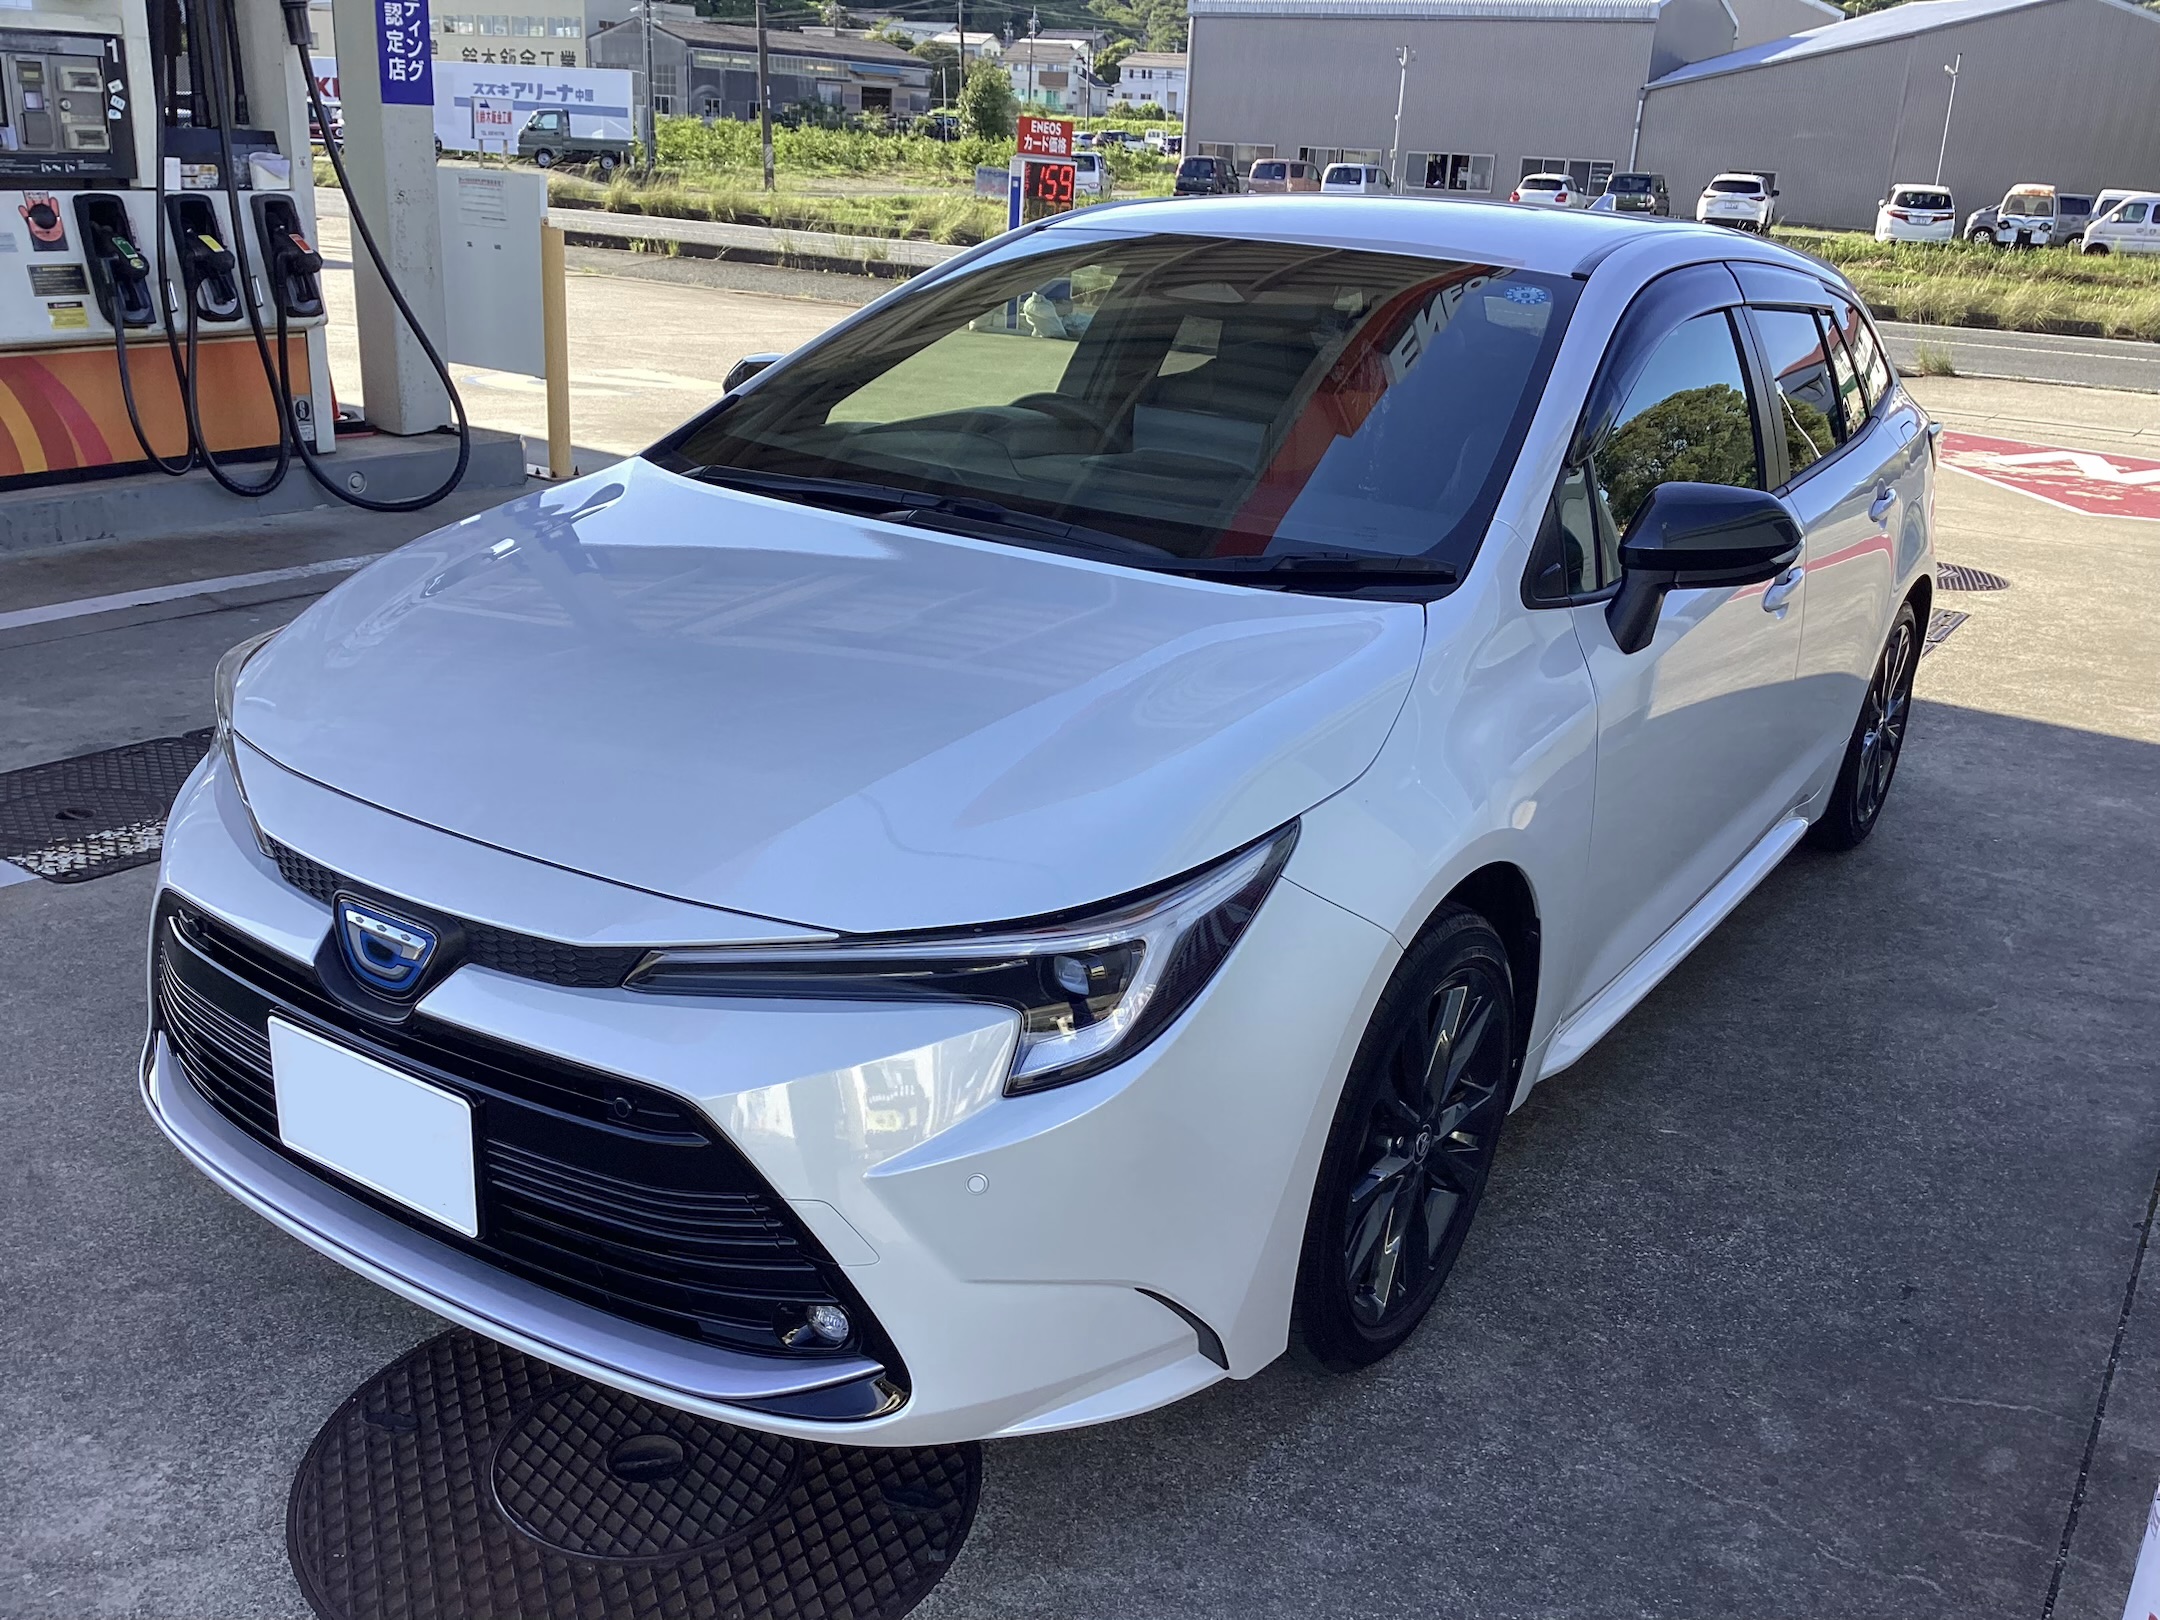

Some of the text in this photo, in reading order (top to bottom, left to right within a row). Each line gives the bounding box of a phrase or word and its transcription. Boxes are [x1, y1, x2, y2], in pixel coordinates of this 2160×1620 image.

[384, 2, 406, 81] 認定店
[1031, 120, 1061, 135] ENEOS
[1024, 134, 1067, 154] カード価格
[1038, 164, 1073, 200] 159
